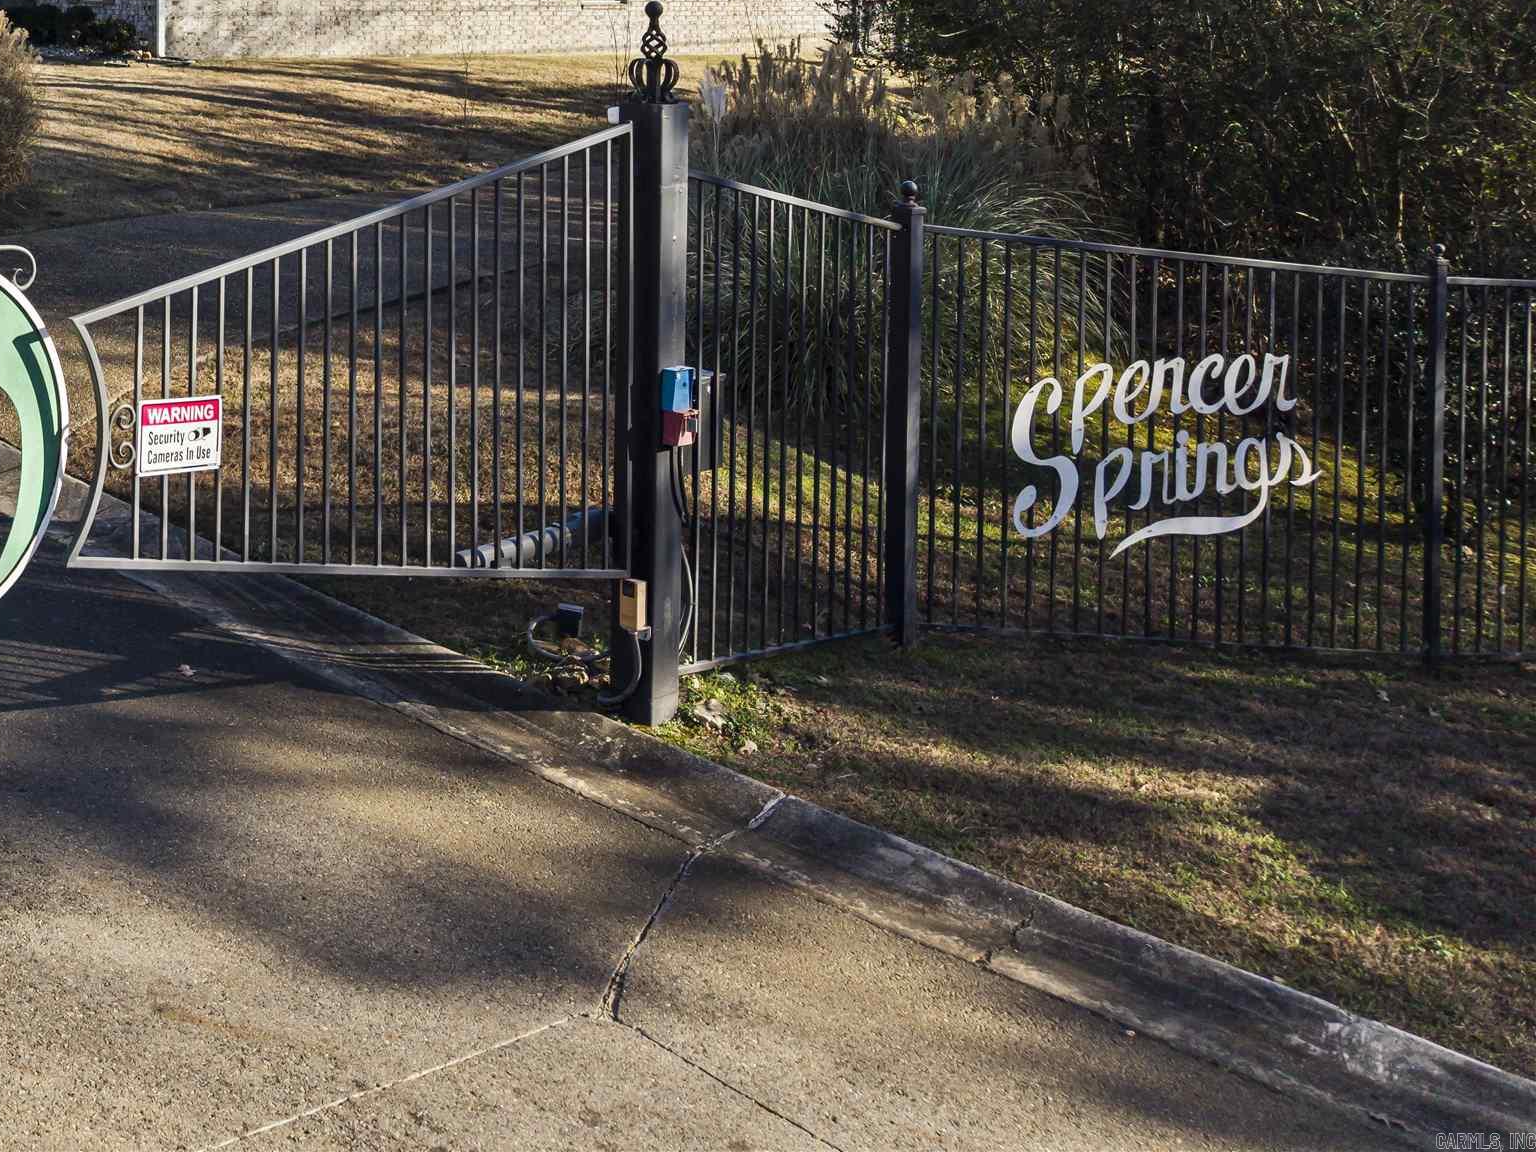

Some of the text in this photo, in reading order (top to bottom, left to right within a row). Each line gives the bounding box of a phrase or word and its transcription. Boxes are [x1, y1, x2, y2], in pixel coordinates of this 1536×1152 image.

[147, 404, 214, 425] WARNING
[148, 430, 185, 446] Security
[1012, 353, 1297, 538] Spencer
[147, 446, 211, 465] Cameras In Use
[1012, 378, 1322, 559] Springs
